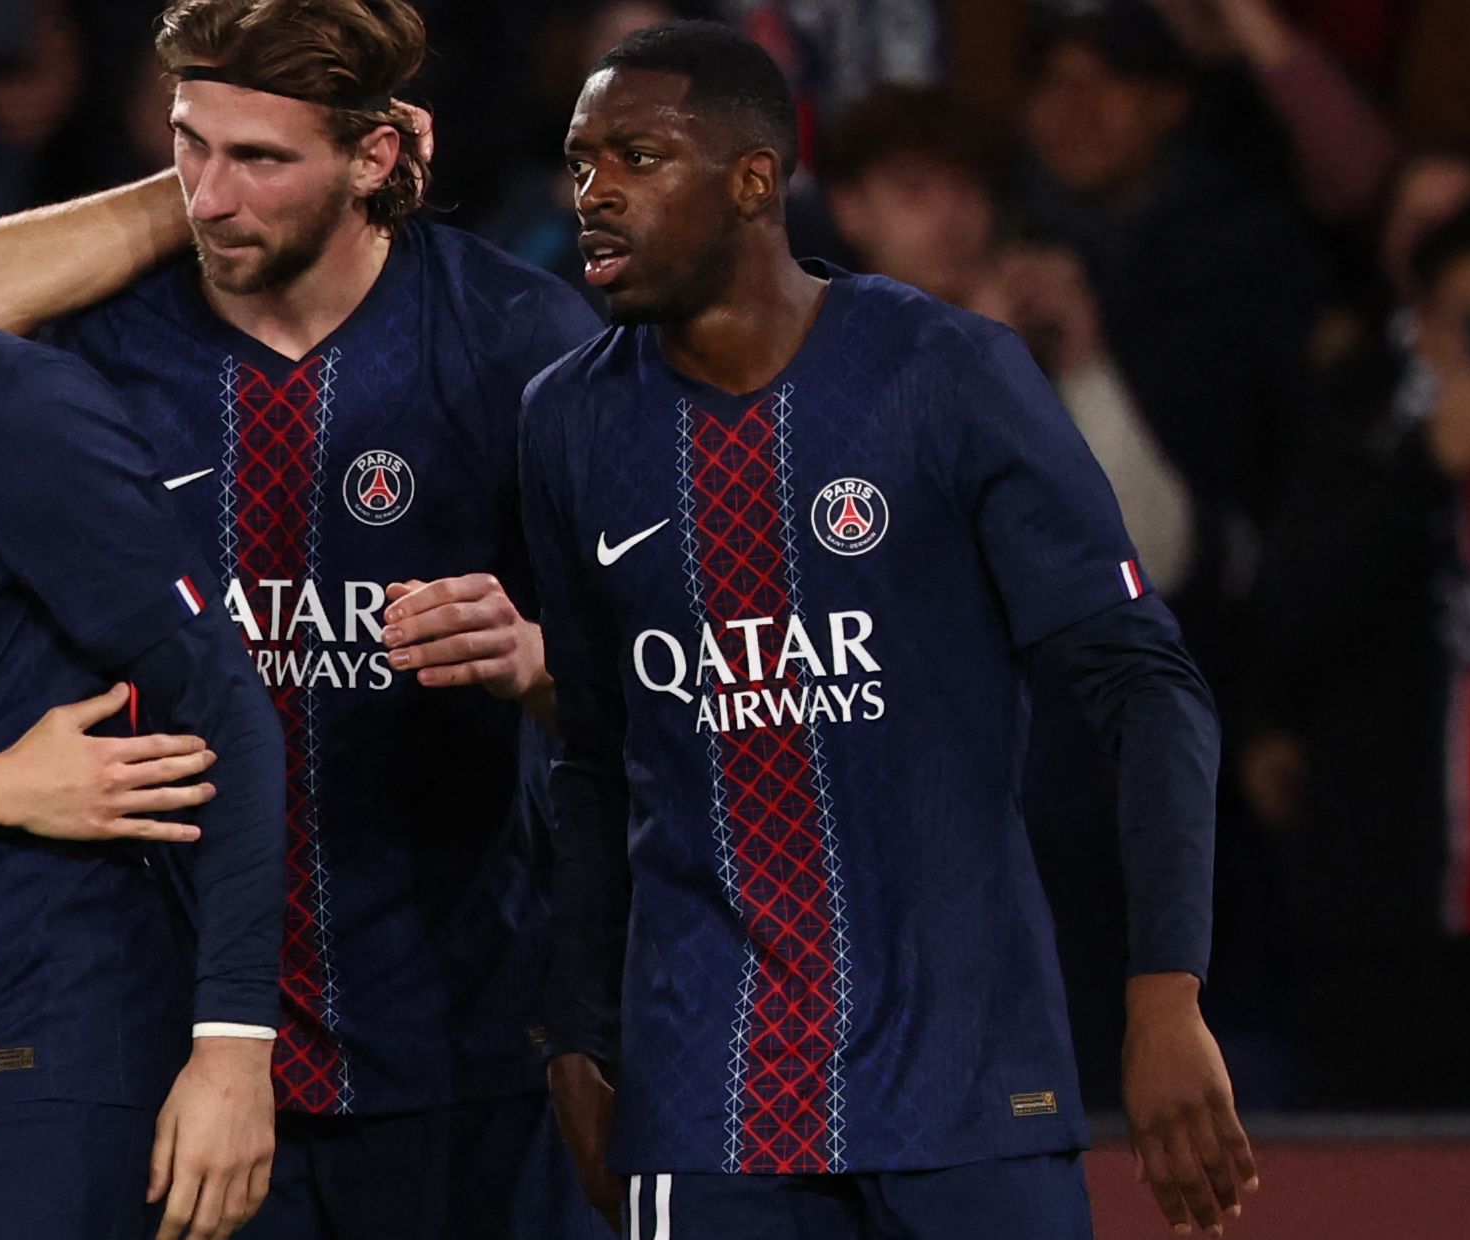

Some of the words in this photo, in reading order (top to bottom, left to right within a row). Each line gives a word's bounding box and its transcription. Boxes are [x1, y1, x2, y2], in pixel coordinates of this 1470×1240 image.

[356, 454, 403, 472] PARIS
[823, 482, 874, 502] PARIS
[224, 578, 386, 643] ATAR
[248, 649, 393, 690] RWAYS
[633, 610, 882, 704] QATAR
[695, 680, 885, 733] AIRWAYS
